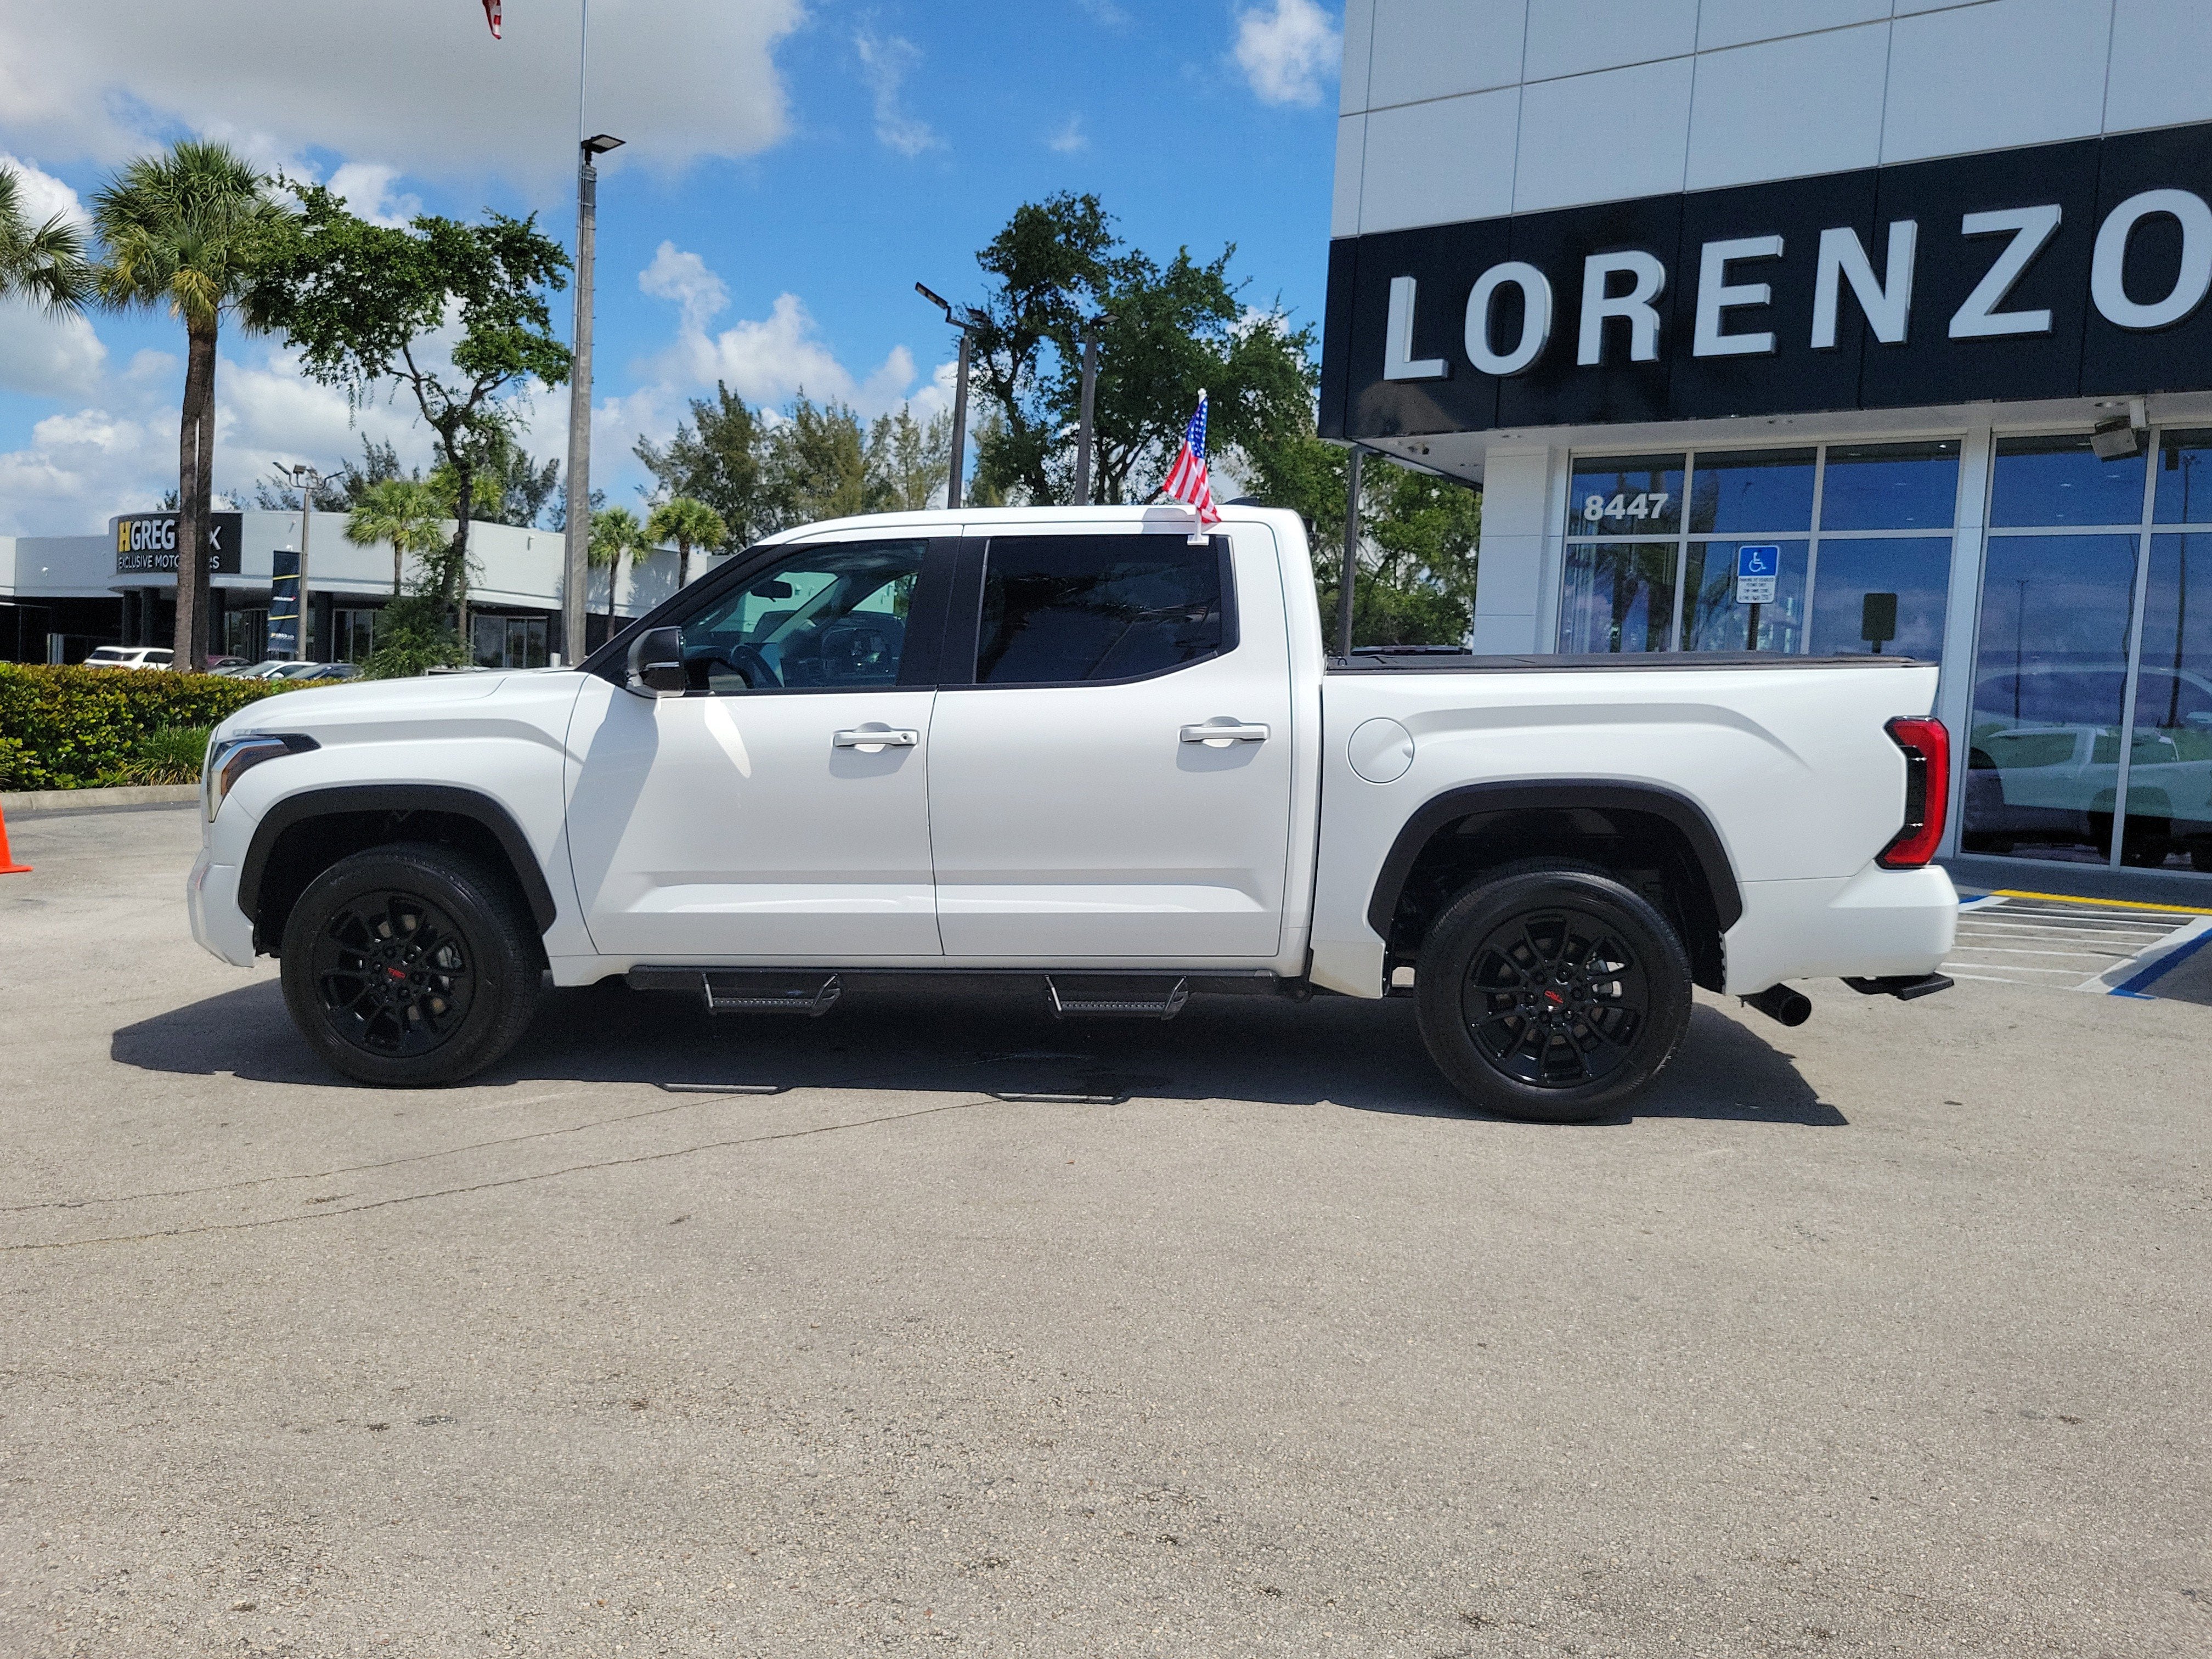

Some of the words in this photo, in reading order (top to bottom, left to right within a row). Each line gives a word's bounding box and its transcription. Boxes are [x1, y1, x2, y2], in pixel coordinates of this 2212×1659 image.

[1383, 188, 2212, 380] LORENZO
[1584, 493, 1669, 521] 8447
[119, 519, 176, 552] HGREG
[119, 555, 153, 569] EXCLUSIVE
